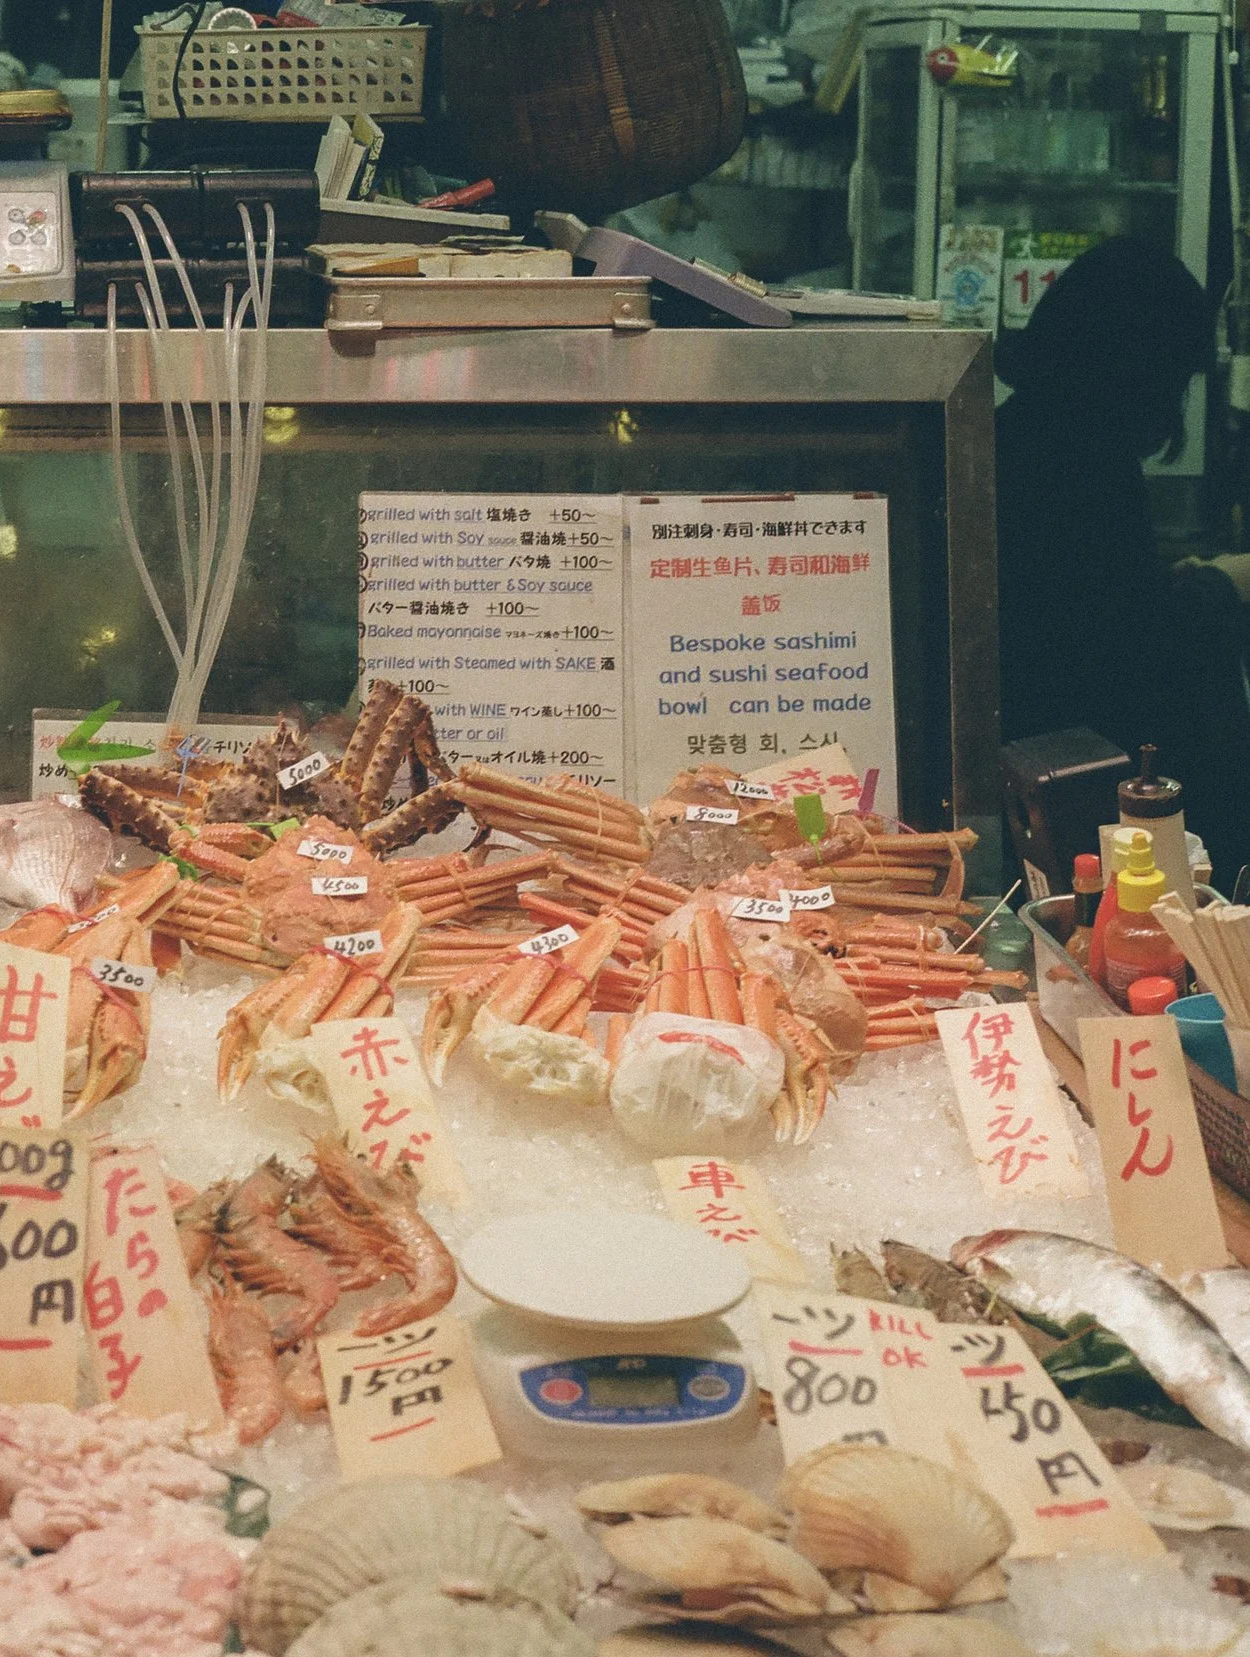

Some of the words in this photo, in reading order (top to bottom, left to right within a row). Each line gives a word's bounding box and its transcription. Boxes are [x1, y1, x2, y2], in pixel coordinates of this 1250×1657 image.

[367, 508, 415, 521] grilled
[419, 508, 451, 520] with
[454, 508, 483, 521] salt
[487, 508, 532, 522] 塩焼き
[370, 531, 418, 545] grilled
[422, 531, 453, 544] with
[458, 533, 485, 546] Soy
[488, 536, 517, 545] sauce
[370, 554, 418, 569] grilled
[422, 555, 454, 568] with
[456, 556, 504, 569] butter
[509, 555, 552, 569] バタ焼
[367, 579, 415, 593] grilled
[419, 579, 451, 592] with
[454, 579, 501, 592] butter
[550, 582, 594, 592] sauce
[367, 601, 470, 615] バター醤油焼き
[741, 594, 782, 616] 盖饭
[367, 625, 413, 638] Baked
[417, 625, 501, 640] mayonnaise
[670, 632, 766, 653] Bespoke
[774, 631, 857, 650] sashimi
[366, 657, 415, 671] grilled
[419, 657, 450, 669] with
[454, 657, 515, 670] Steamed
[519, 657, 551, 669] with
[555, 657, 596, 670] SAKE
[600, 657, 615, 670] 酒
[659, 665, 701, 684] and
[709, 664, 767, 683] sushi
[775, 661, 869, 680] seafood
[435, 704, 466, 716] with
[470, 704, 506, 716] WINE
[510, 705, 563, 718] ワイン蒸し
[658, 696, 707, 716] bowl
[729, 699, 770, 713] can
[778, 695, 805, 712] be
[813, 694, 872, 712] made
[434, 727, 461, 740] tter
[466, 730, 484, 740] or
[487, 727, 504, 740] oil
[687, 733, 747, 755] 맞춤형
[289, 758, 322, 785] 5000
[734, 782, 769, 795] 12000
[310, 844, 347, 860] 5000
[322, 880, 359, 894] 4500
[744, 899, 784, 915] 3500
[333, 937, 375, 957] 4200
[531, 931, 570, 955] 4300
[100, 964, 145, 986] 3500
[1111, 1038, 1174, 1182] にしん
[29, 1279, 75, 1326] 円
[882, 1346, 928, 1369] OK
[339, 1357, 453, 1405] 1500
[783, 1355, 878, 1415] 800
[391, 1384, 444, 1417] 円
[1036, 1451, 1102, 1495] 円
